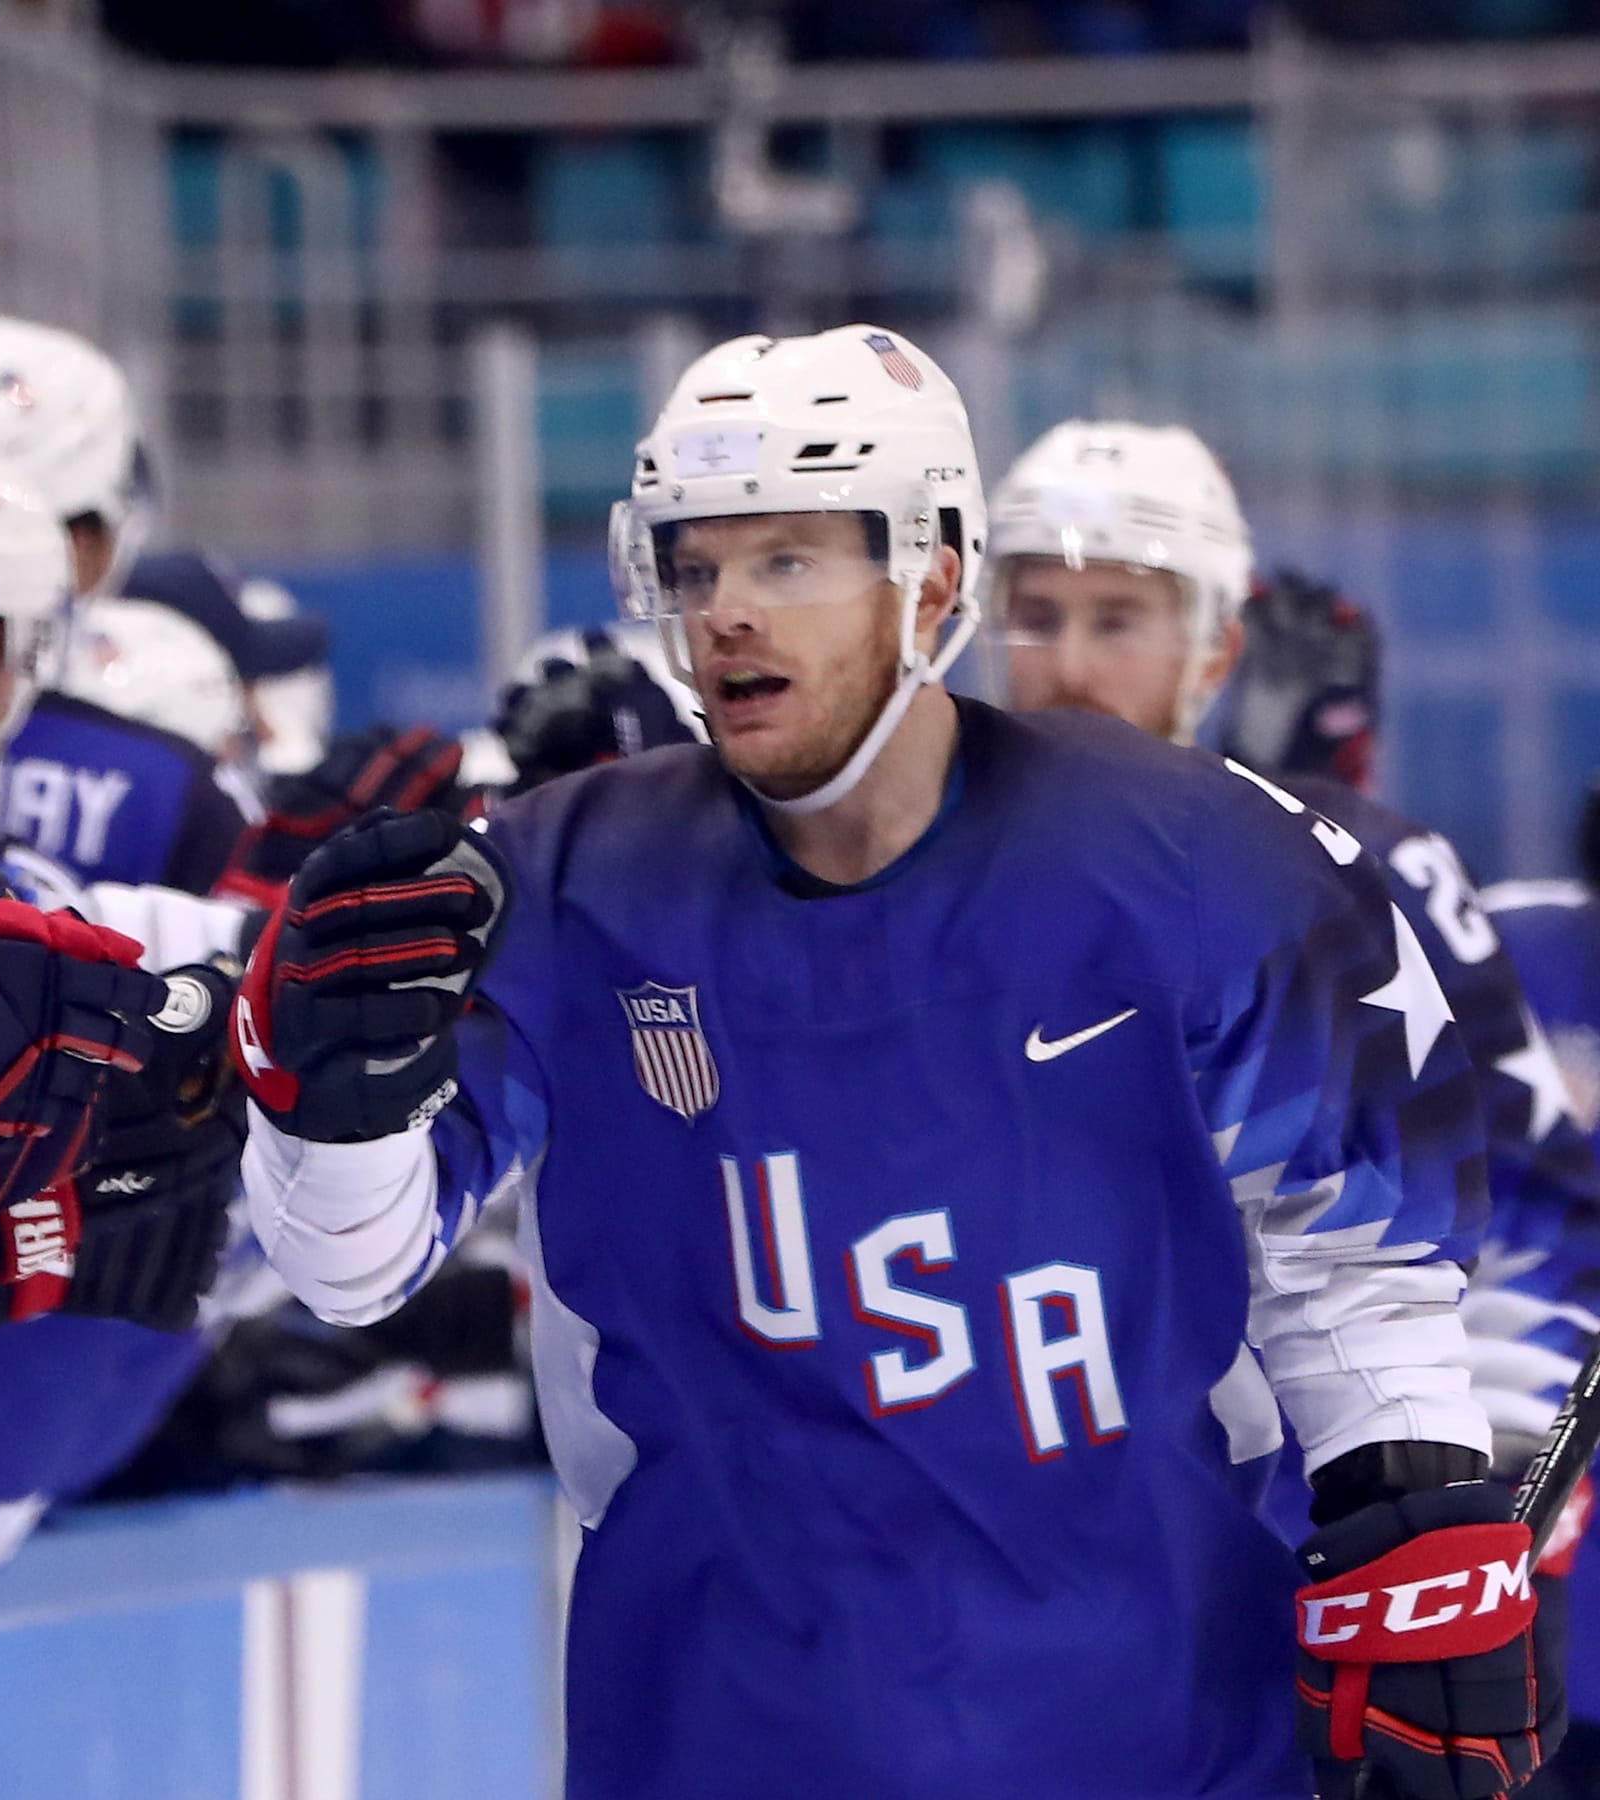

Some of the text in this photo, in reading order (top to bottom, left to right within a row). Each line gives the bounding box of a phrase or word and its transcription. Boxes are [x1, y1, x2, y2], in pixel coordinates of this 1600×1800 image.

[629, 997, 688, 1024] USA
[718, 1150, 1131, 1466] USA
[1302, 1550, 1531, 1645] CCM
